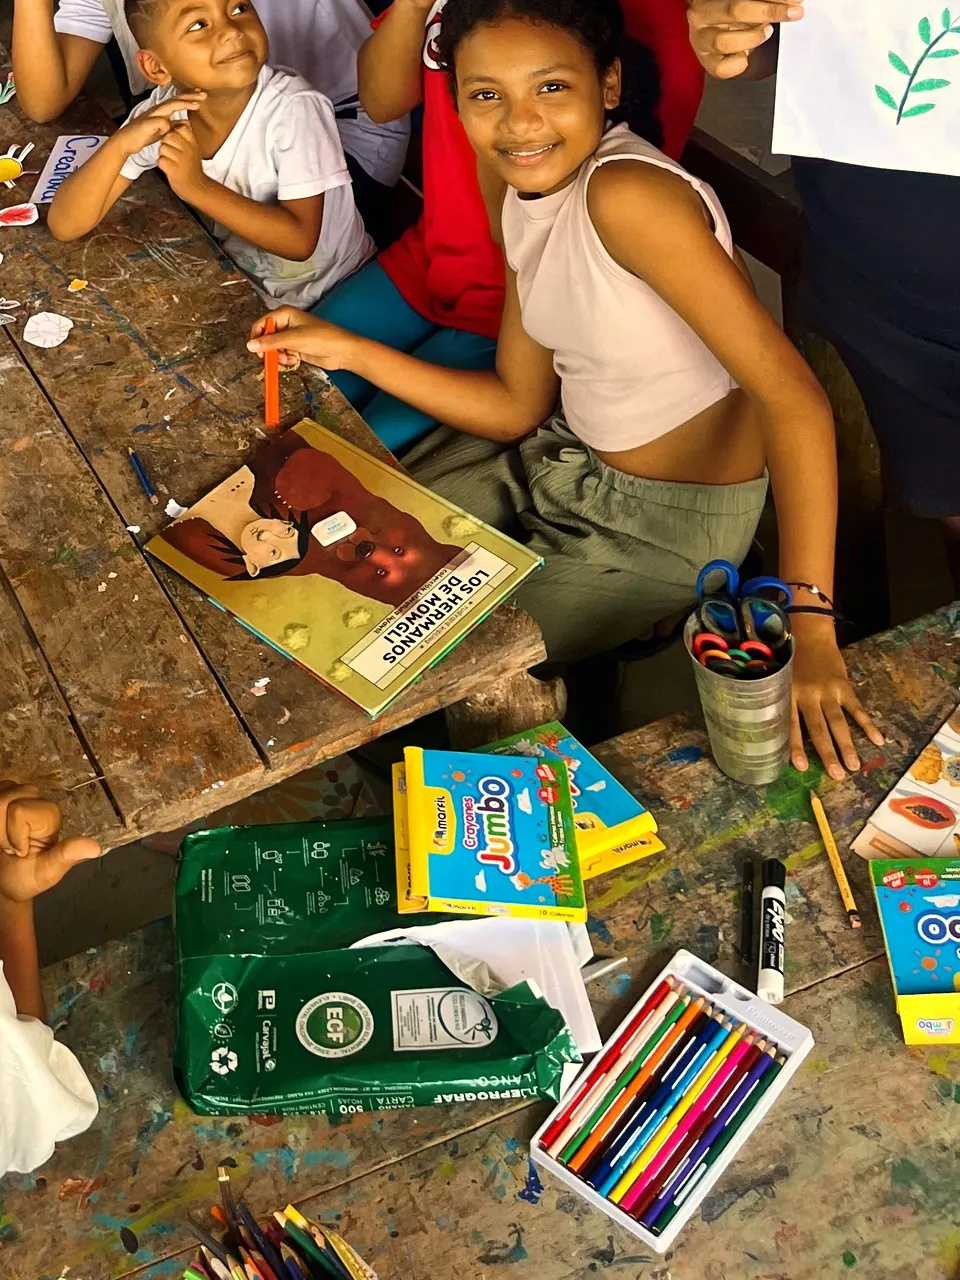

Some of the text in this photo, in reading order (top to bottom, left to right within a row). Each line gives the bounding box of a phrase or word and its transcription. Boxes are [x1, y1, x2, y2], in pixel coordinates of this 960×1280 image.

[382, 569, 490, 665] LOS HERMANOS
[383, 575, 462, 644] DE MOWGLI
[437, 795, 448, 830] marfil
[463, 797, 477, 848] Crayones
[477, 778, 511, 871] Jumbo
[766, 899, 785, 943] EXPO
[260, 1019, 272, 1060] Carvajal
[326, 1007, 344, 1044] ECF
[917, 1018, 952, 1032] Jumbo
[339, 1104, 364, 1114] 500
[375, 1095, 415, 1105] CARTA
